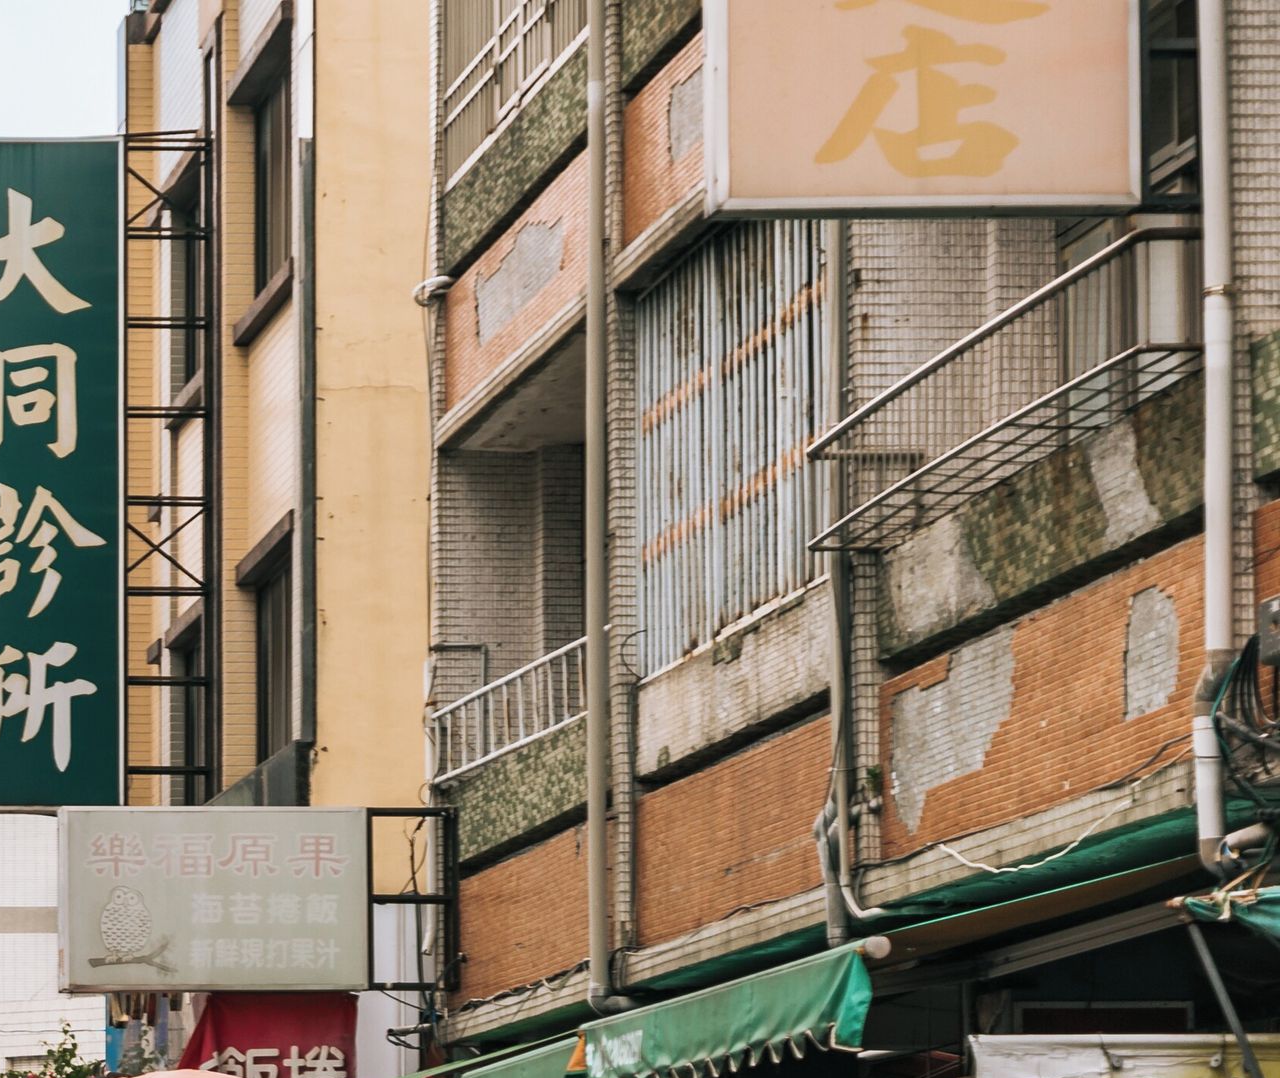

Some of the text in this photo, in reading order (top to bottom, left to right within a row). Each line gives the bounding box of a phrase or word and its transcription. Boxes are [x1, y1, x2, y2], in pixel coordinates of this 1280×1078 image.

[814, 0, 1043, 177] 店
[87, 832, 349, 878] 樂福原果
[191, 893, 339, 925] 海苔捲飯
[190, 938, 340, 970] 新鮮現打果汁
